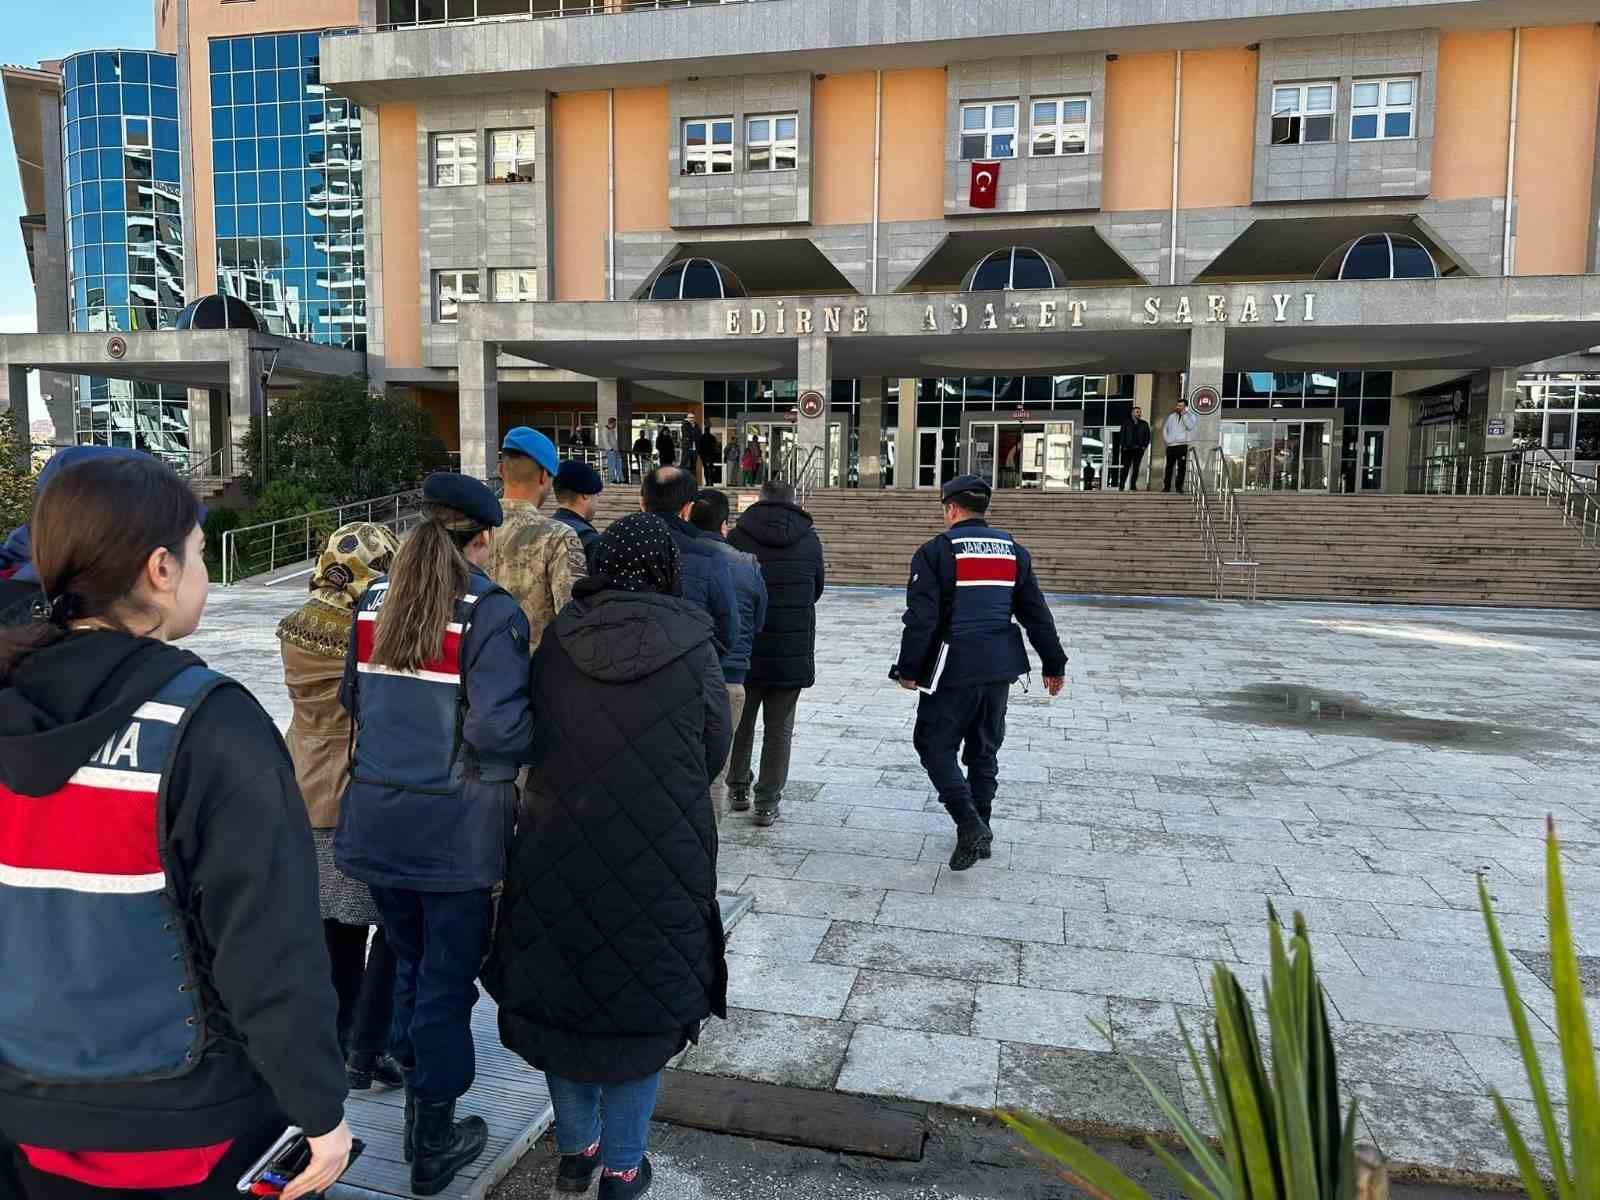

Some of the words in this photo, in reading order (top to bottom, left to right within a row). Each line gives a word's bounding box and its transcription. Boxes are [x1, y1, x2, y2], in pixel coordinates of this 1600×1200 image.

[726, 300, 869, 334] EDİRNE
[920, 301, 1088, 330] ADALET
[1143, 294, 1316, 325] SARAYI
[961, 541, 1012, 555] JANDARMA
